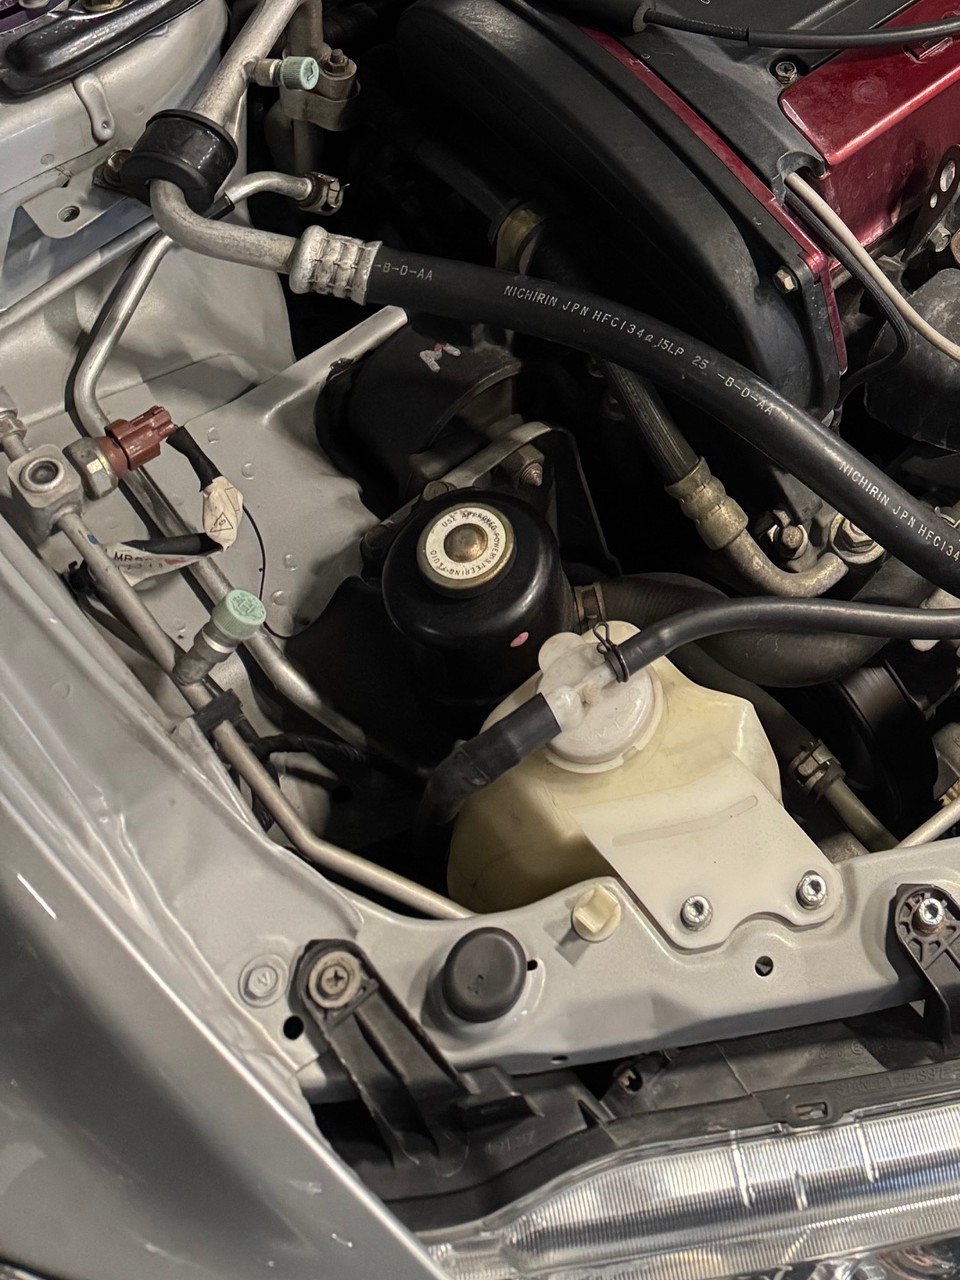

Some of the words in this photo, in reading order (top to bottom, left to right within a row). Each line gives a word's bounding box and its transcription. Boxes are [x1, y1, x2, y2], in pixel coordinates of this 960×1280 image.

[503, 285, 558, 307] NICHIRIN
[562, 301, 590, 317] JPN
[838, 461, 890, 506] NICHIRIN
[892, 505, 916, 526] JPN
